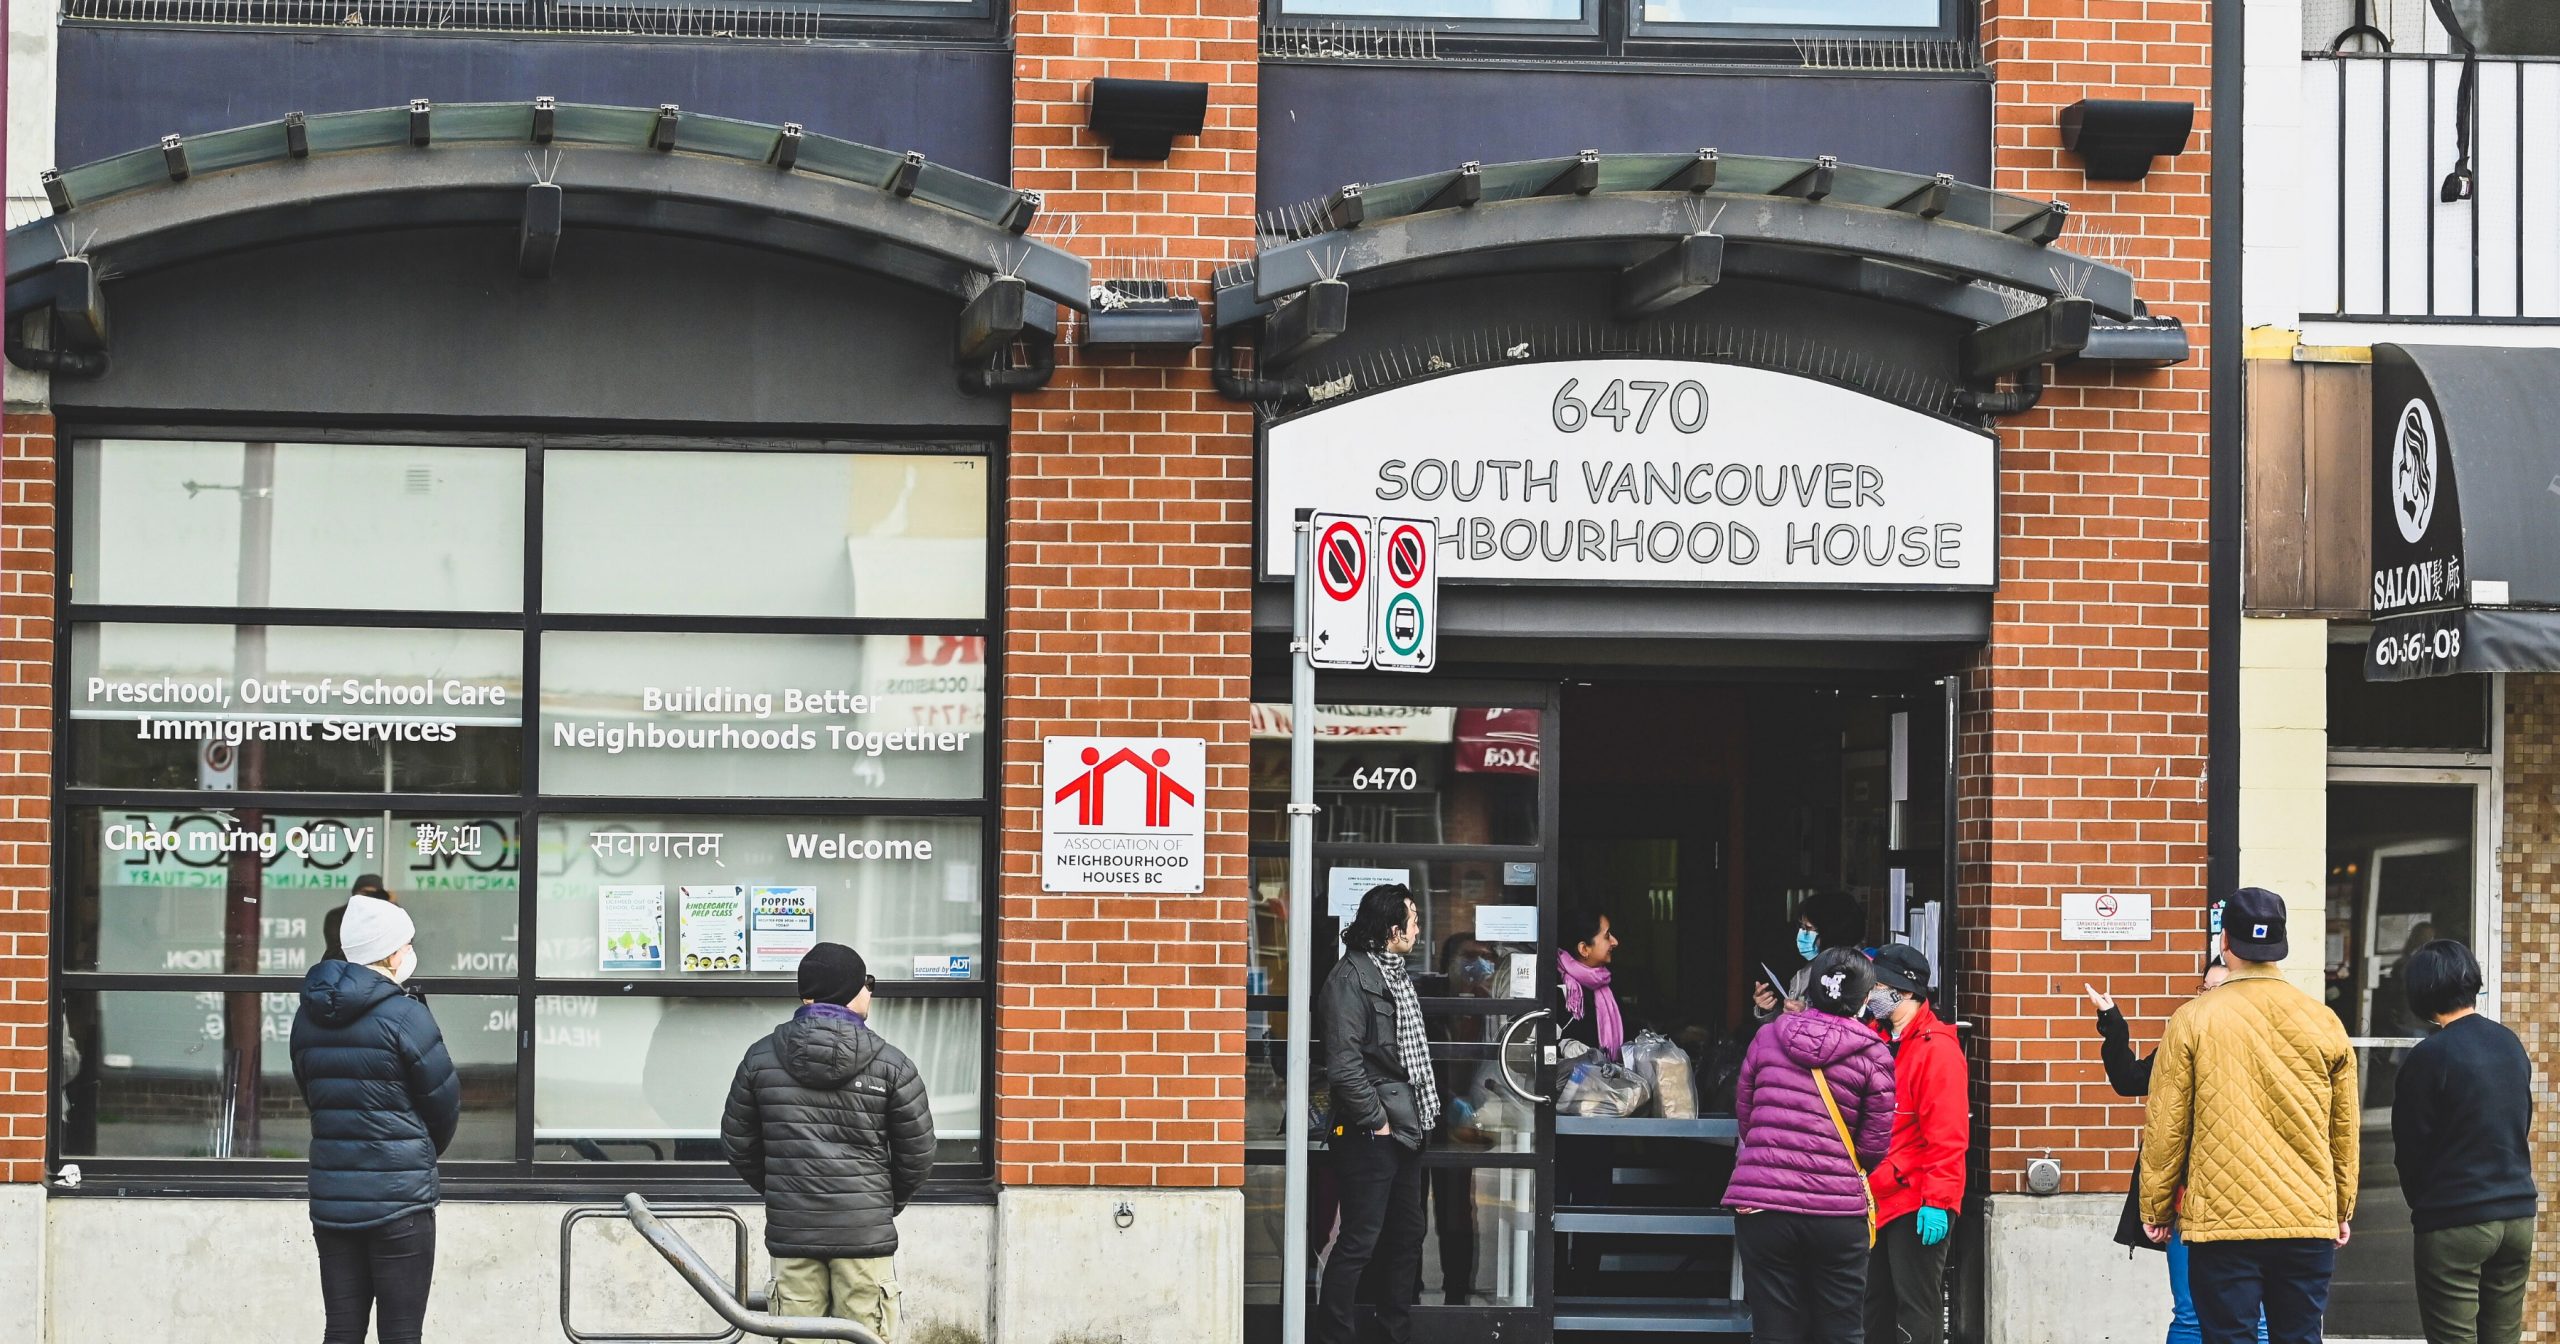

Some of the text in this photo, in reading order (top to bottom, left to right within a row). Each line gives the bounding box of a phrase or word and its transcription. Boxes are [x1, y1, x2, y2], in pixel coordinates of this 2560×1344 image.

[1552, 377, 1710, 434] 6470
[1375, 459, 1886, 508] SOUTH VANCOUVER
[1434, 516, 1964, 569] HBOURHOOD HOUSE
[2374, 561, 2432, 611] SALON
[87, 677, 506, 708] Preschool, Out-of-School Care
[642, 686, 882, 719] Building Better
[137, 715, 457, 747] Immigrant Services
[553, 722, 970, 757] Neighbourhoods Together
[1352, 767, 1417, 790] 6470
[105, 822, 182, 851] Chào
[189, 823, 277, 858] mừng
[342, 826, 374, 859] Vị
[415, 823, 482, 856] 歡迎
[786, 833, 932, 860] Welcome
[1063, 837, 1183, 851] ASSOCIATION OF
[1056, 854, 1189, 868] NEIGHBOURHOOD
[1082, 871, 1163, 885] HOUSES BC
[686, 902, 739, 910] KINDERGARTEN
[691, 909, 733, 917] PREP CLASS
[761, 897, 805, 906] POPPINS
[951, 959, 969, 970] ADT
[1516, 967, 1530, 975] SAFE
